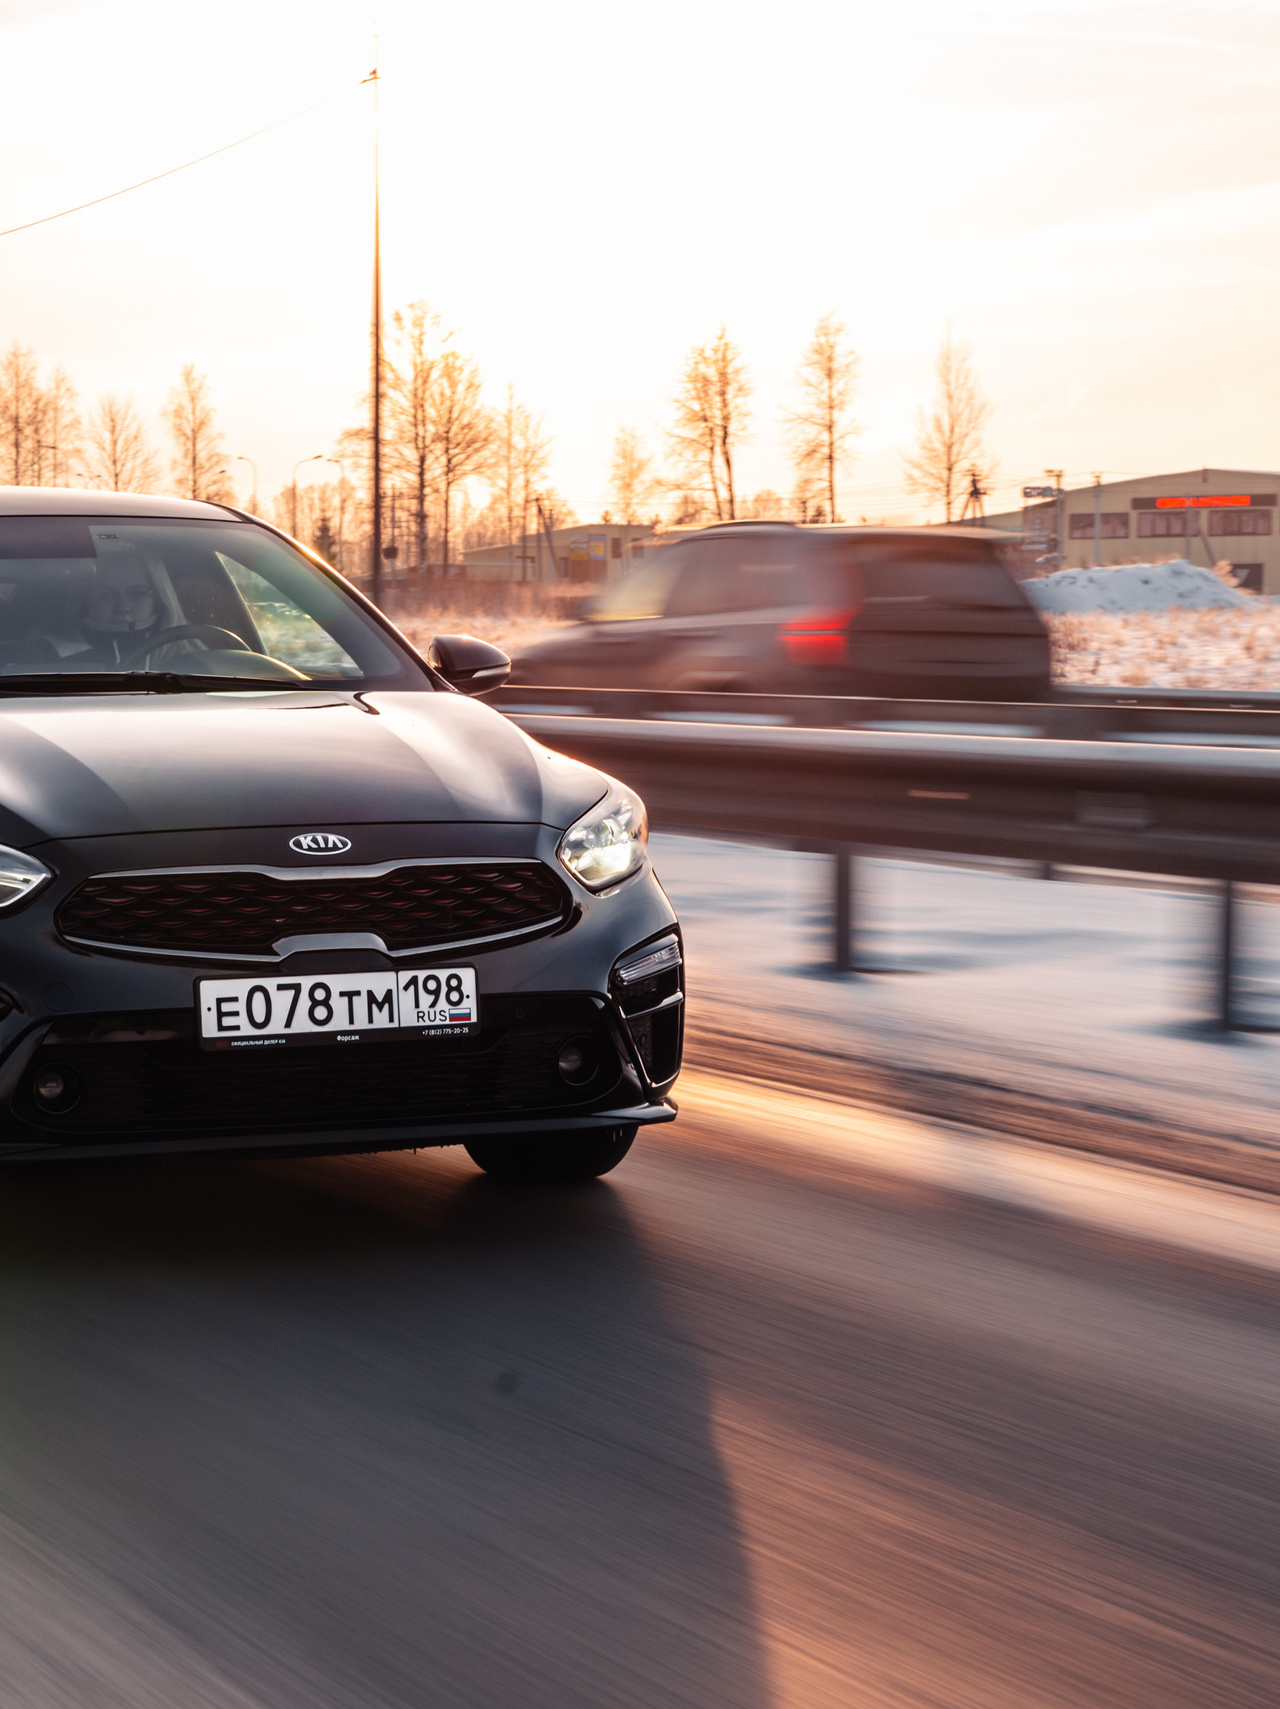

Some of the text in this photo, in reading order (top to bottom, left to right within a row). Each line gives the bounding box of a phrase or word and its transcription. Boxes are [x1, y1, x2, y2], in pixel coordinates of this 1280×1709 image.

[298, 835, 344, 850] KIA
[215, 973, 464, 1032] Е078ТМ 198
[416, 1009, 448, 1024] RUS
[336, 1034, 360, 1042] Форсаж
